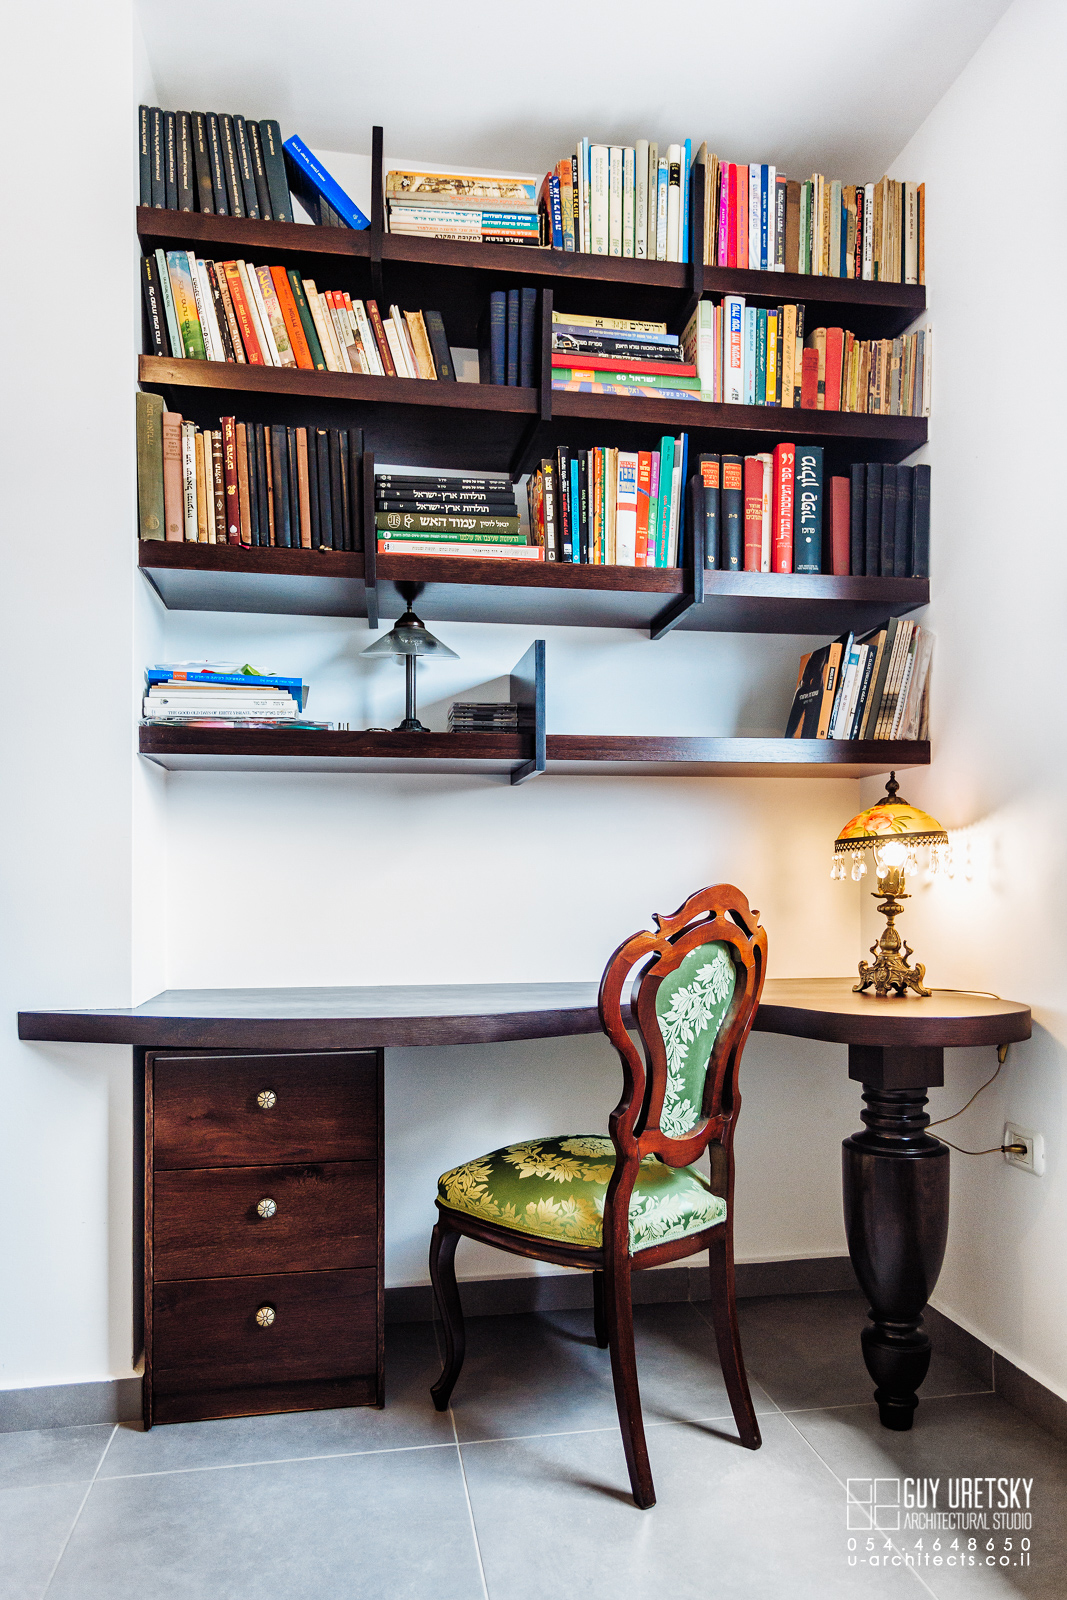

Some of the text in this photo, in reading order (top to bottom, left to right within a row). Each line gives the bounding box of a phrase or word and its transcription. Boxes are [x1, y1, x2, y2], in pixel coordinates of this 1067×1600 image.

[552, 188, 562, 230] אנדלוסיה
[232, 330, 242, 354] שלגיות
[226, 444, 234, 470] תהלים
[184, 468, 192, 490] ישראל
[796, 456, 820, 488] מילון
[413, 490, 486, 501] תולדות ארץ-ישראל
[776, 466, 792, 540] ספר הציטטות הגדול
[416, 502, 490, 514] תולדות ארץ-ישראל
[420, 516, 447, 527] האש
[448, 518, 476, 529] עמוד
